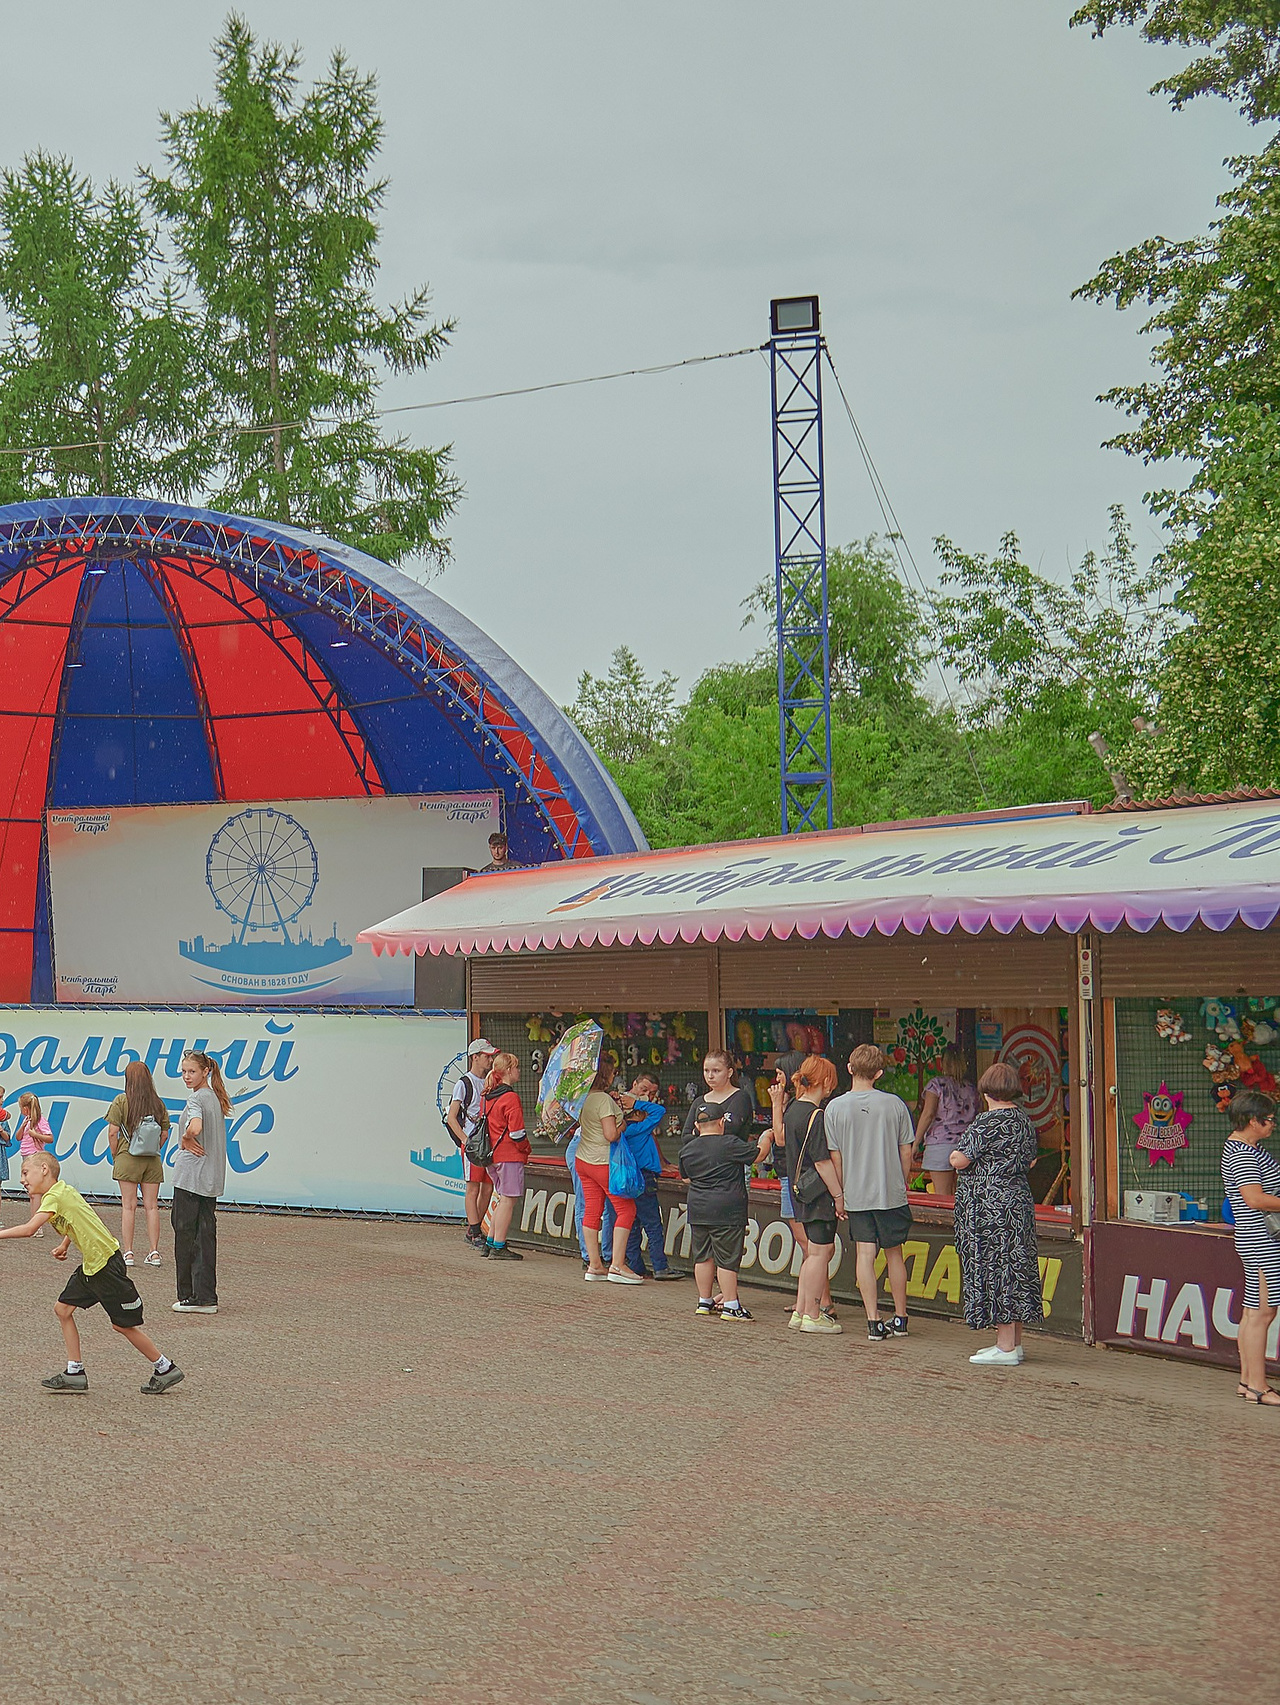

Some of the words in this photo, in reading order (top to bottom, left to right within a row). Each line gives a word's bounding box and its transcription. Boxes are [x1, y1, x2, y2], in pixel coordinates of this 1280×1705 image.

[419, 799, 492, 811] Центральный
[52, 812, 111, 825] Центральный
[447, 809, 490, 824] Парк
[74, 821, 109, 834] Парк
[558, 824, 1162, 905] Центральный
[60, 975, 118, 985] Центральный
[221, 973, 260, 987] ОСНОВАН
[261, 977, 267, 987] В
[268, 977, 286, 987] 1828
[287, 973, 310, 985] ГОДУ
[82, 983, 117, 997] Парк
[1142, 1123, 1159, 1137] ДЕТИ
[1160, 1123, 1184, 1138] ВСЕГДА
[1138, 1133, 1185, 1150] ВЫИГРЫВАЮТ
[1115, 1274, 1280, 1361] НАЧ
